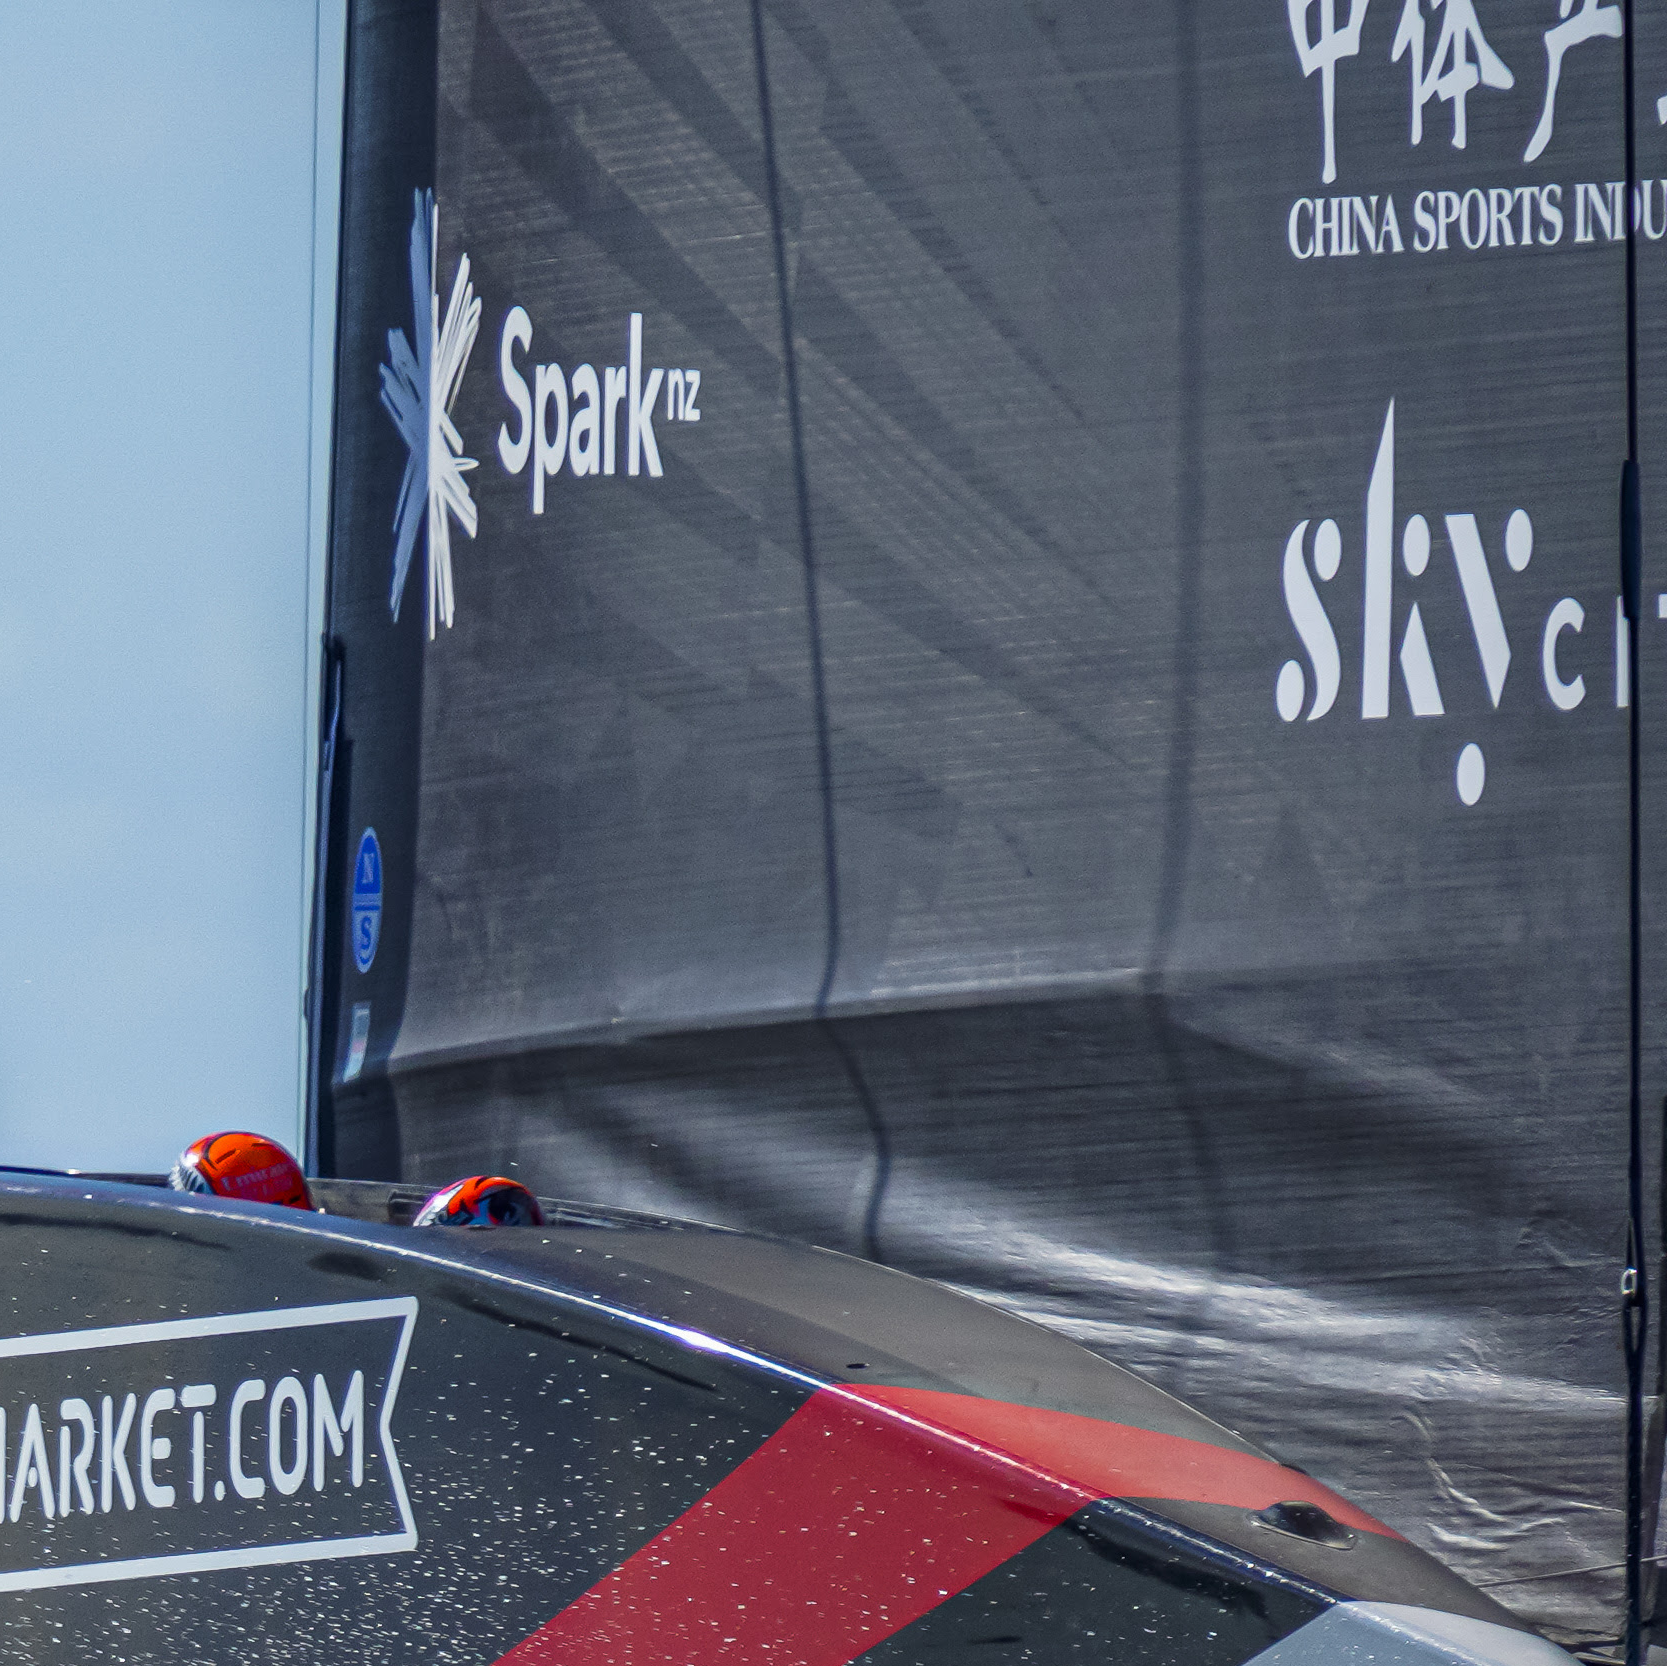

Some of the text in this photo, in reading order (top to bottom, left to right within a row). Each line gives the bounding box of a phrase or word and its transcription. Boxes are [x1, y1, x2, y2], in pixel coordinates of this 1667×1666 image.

[1287, 194, 1405, 260] CHINA
[1413, 183, 1564, 253] SPORTS
[497, 305, 665, 515] Spark
